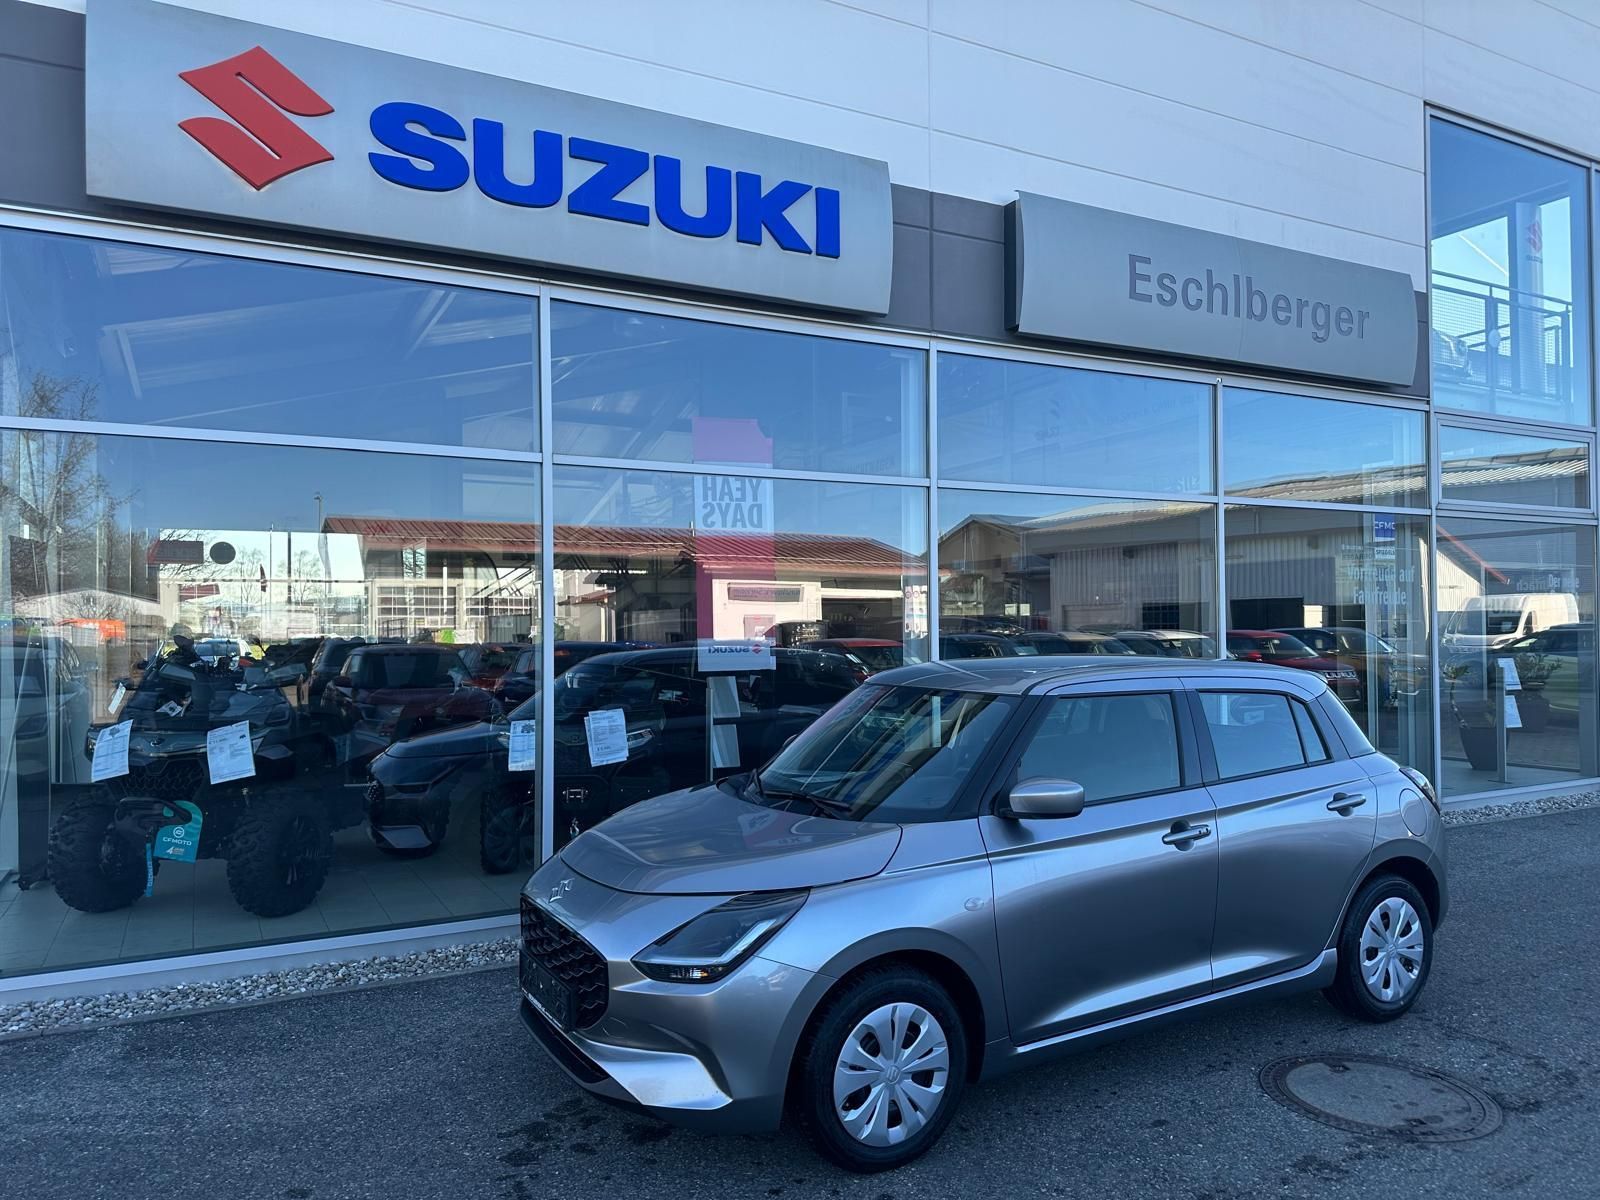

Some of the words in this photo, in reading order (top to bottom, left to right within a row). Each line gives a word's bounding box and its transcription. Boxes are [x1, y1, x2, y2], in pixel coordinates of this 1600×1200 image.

[368, 101, 840, 259] SUZUKI
[1128, 254, 1370, 343] Eschlberger
[1399, 566, 1415, 582] auf
[162, 837, 192, 846] CFMOTO
